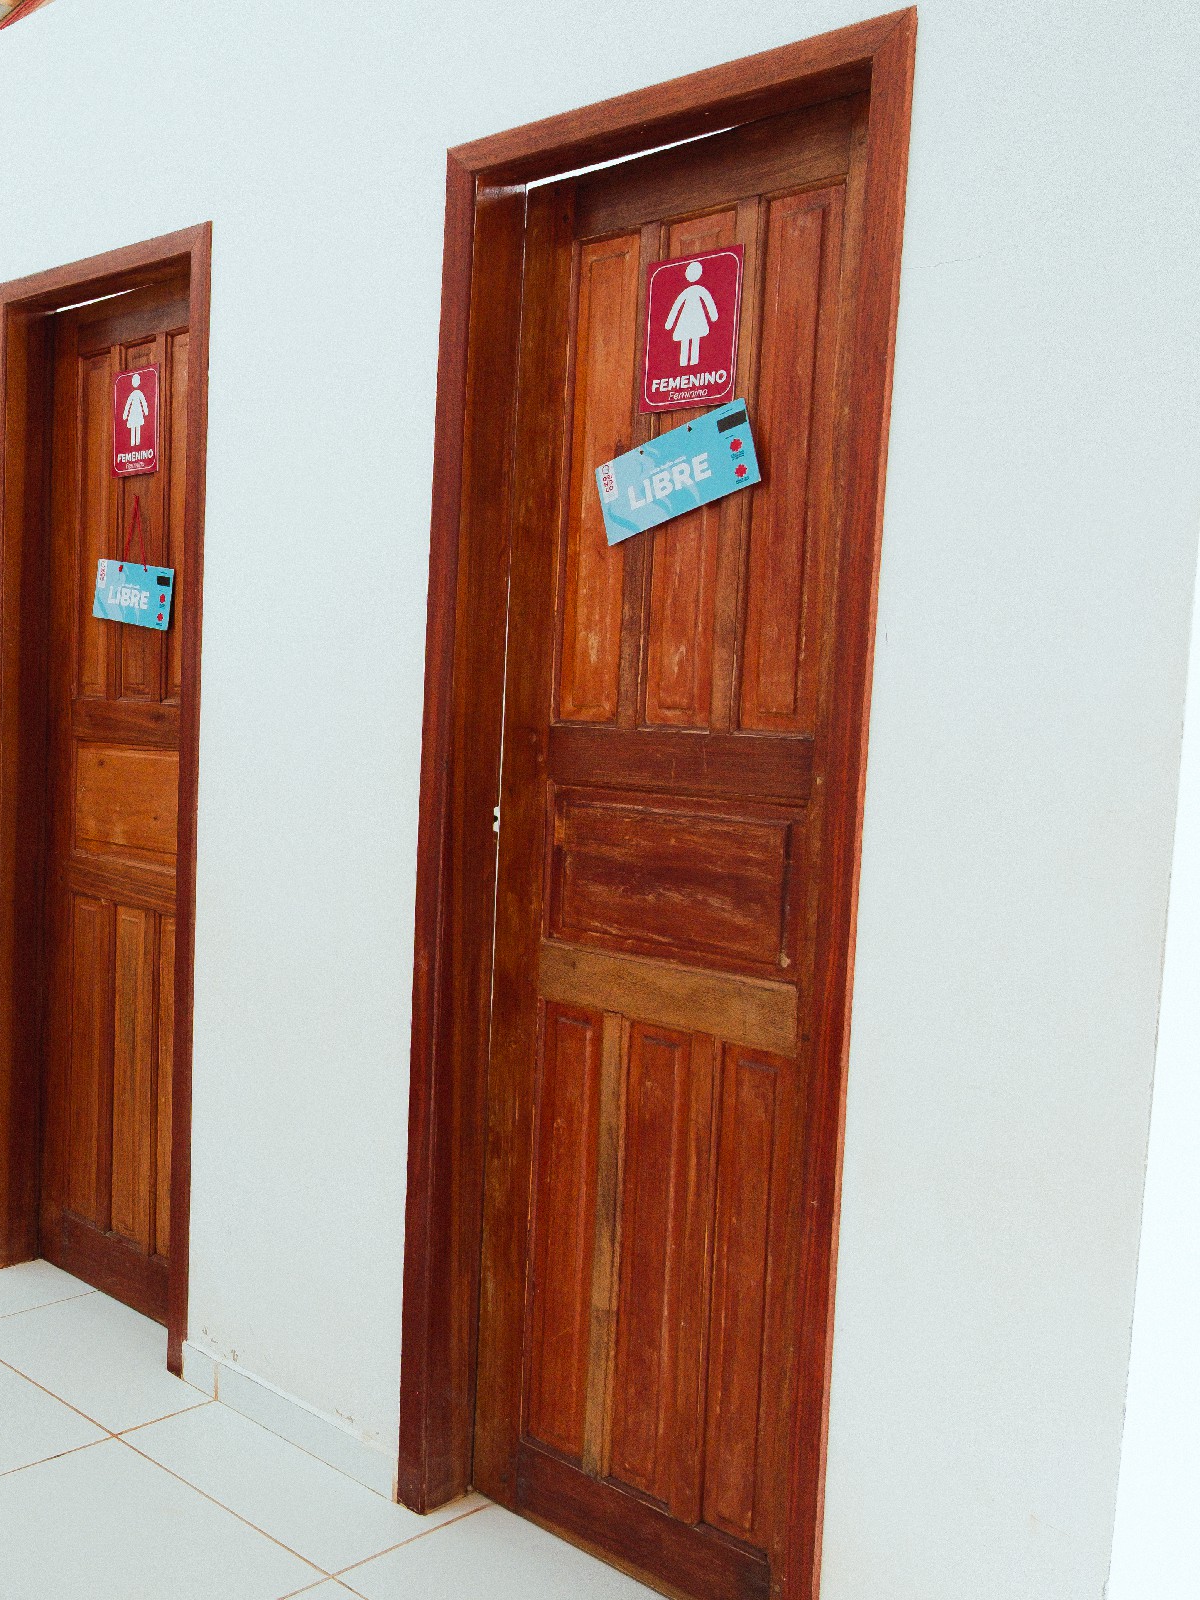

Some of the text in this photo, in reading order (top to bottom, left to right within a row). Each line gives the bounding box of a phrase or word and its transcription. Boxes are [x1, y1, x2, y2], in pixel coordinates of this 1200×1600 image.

[652, 370, 727, 392] FEMENINO
[668, 389, 708, 400] Feminino
[117, 449, 154, 463] FEMENINO
[627, 452, 712, 511] LIBRE
[107, 585, 150, 610] LIBRE
